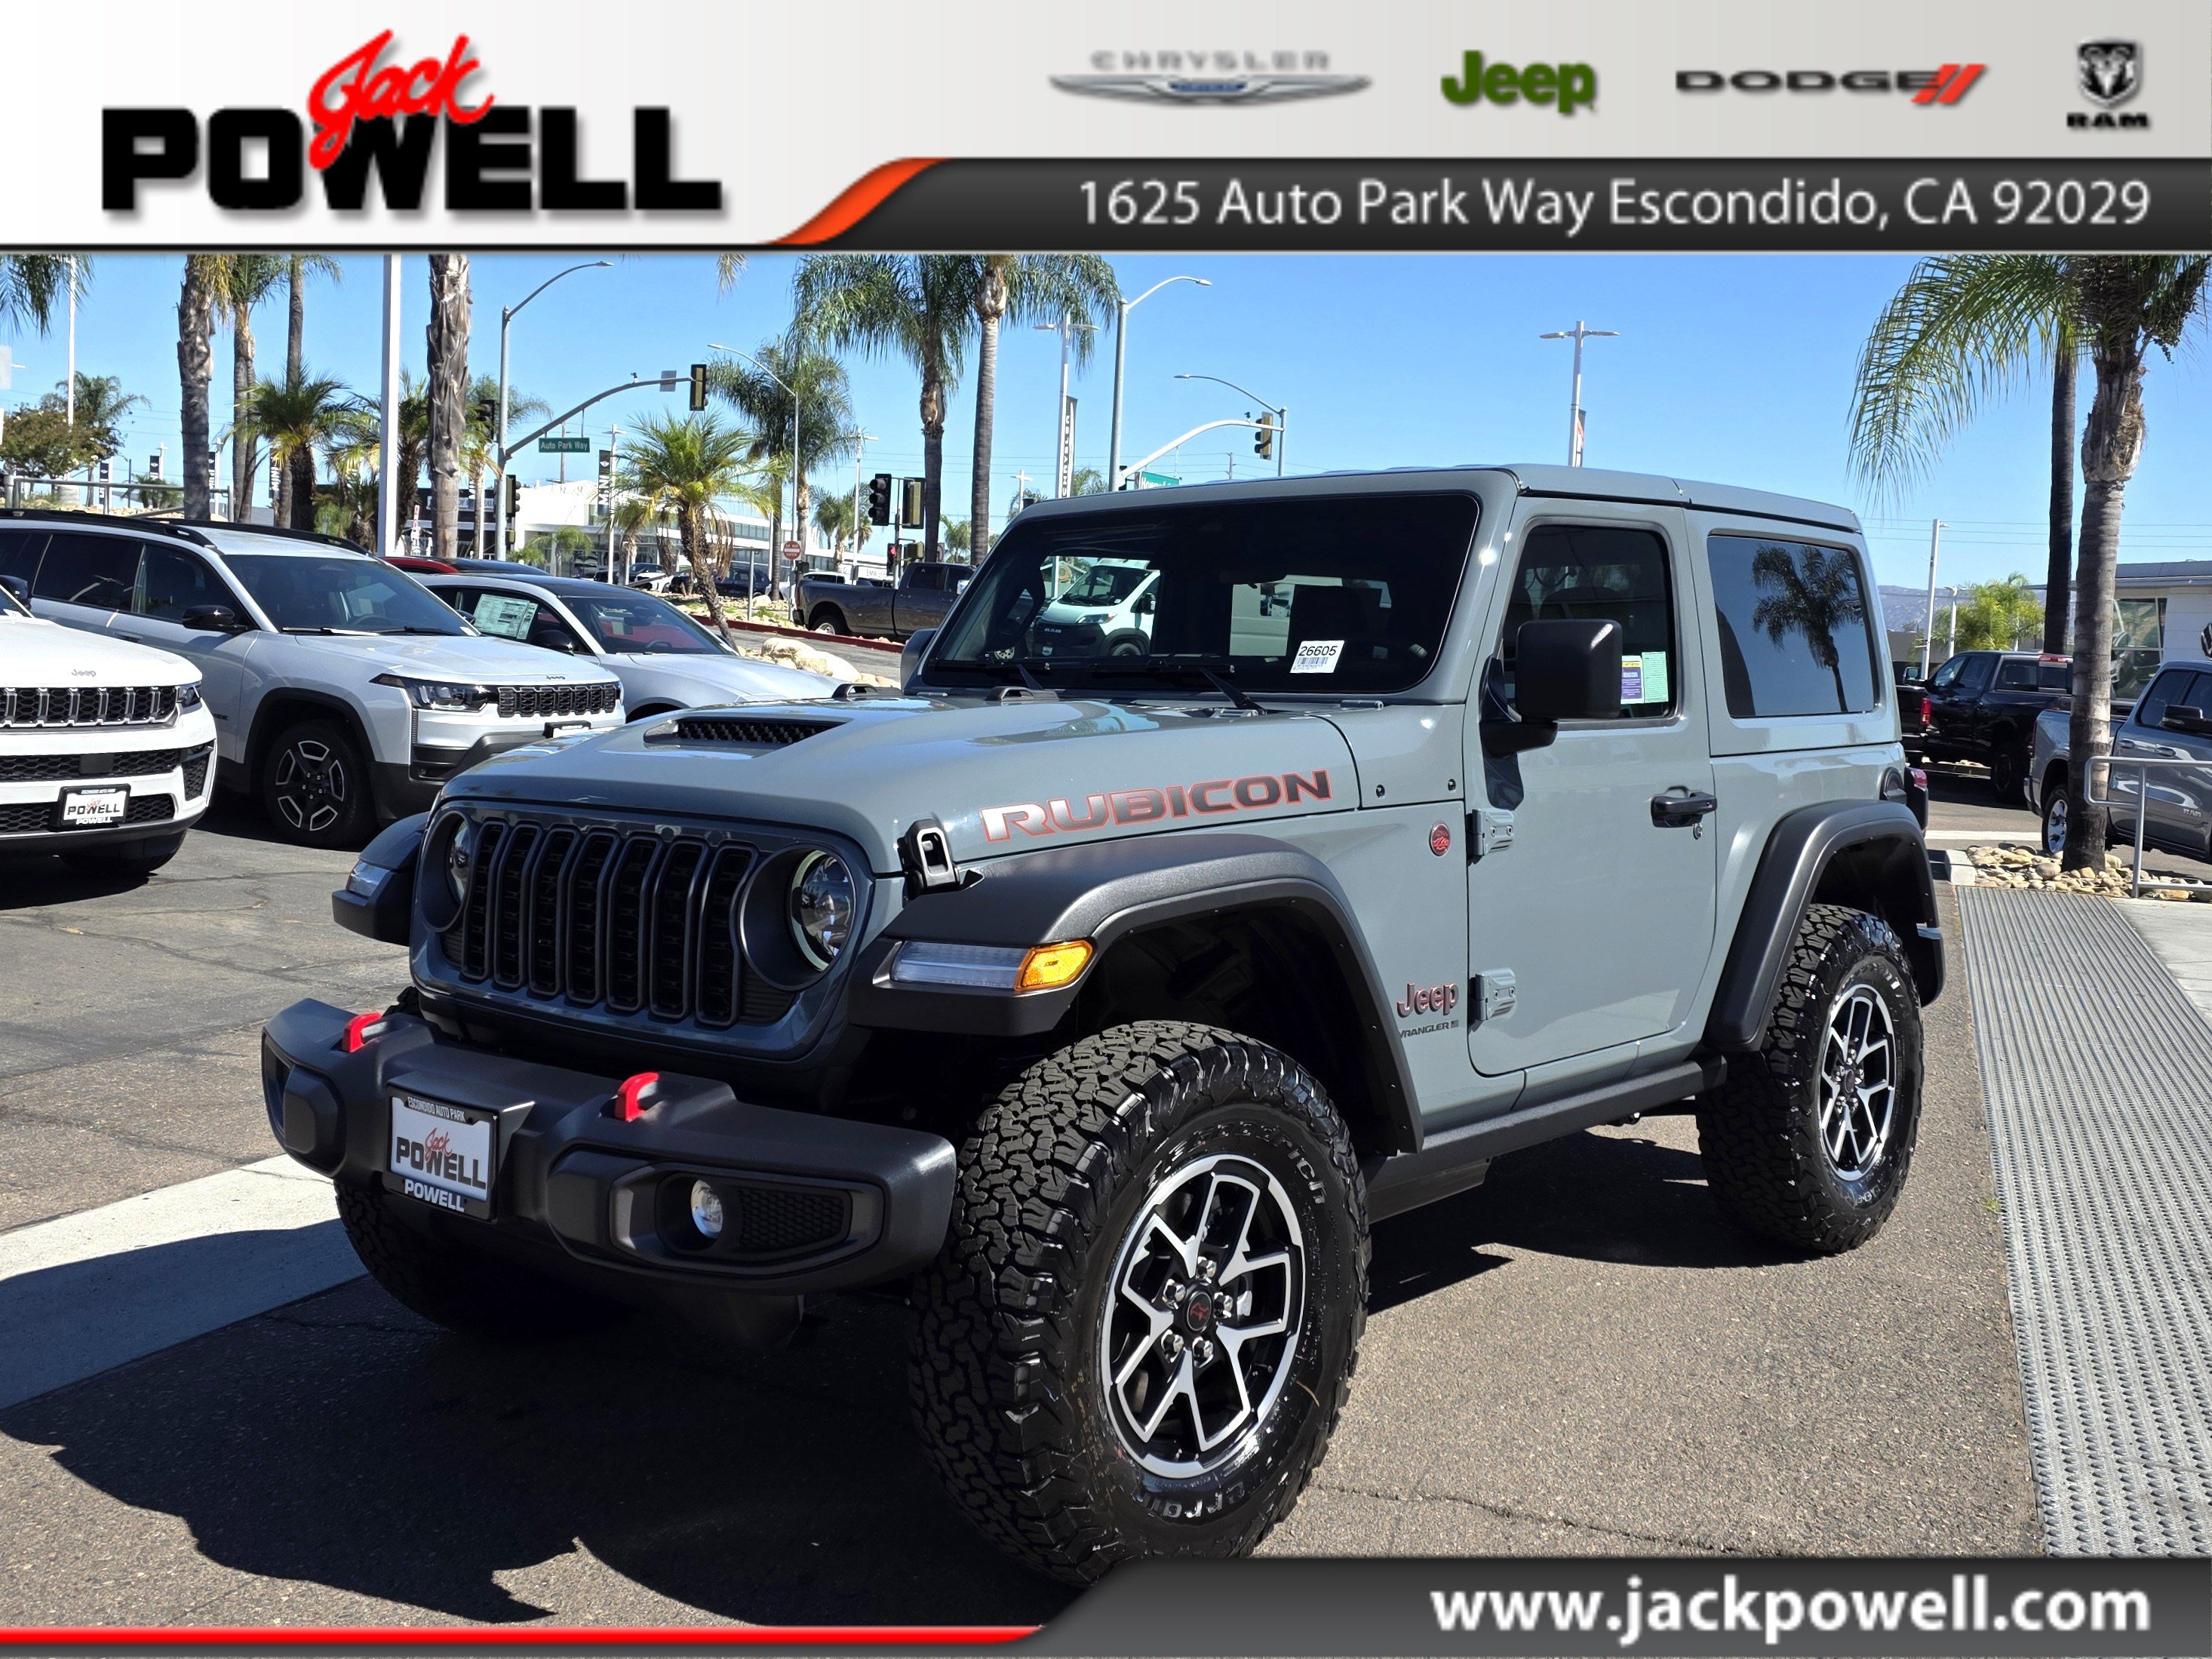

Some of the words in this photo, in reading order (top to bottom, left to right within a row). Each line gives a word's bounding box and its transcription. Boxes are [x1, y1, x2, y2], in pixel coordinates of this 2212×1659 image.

[540, 441, 556, 450] Auto
[558, 441, 573, 450] Park
[574, 441, 588, 450] Way
[1298, 645, 1338, 656] 26605
[71, 668, 97, 677] Jeep
[67, 803, 120, 816] POWELL
[980, 770, 1332, 843] RUBICON
[2183, 808, 2201, 817] RAM
[75, 816, 113, 825] POWELL
[1396, 983, 1459, 1018] Jeep
[407, 1096, 435, 1114] ESCONDIDO
[436, 1104, 450, 1120] AUTO
[450, 1108, 465, 1123] PARK
[425, 1127, 453, 1163] Jack
[396, 1136, 486, 1190] POWELL
[404, 1178, 465, 1213] POWELL
